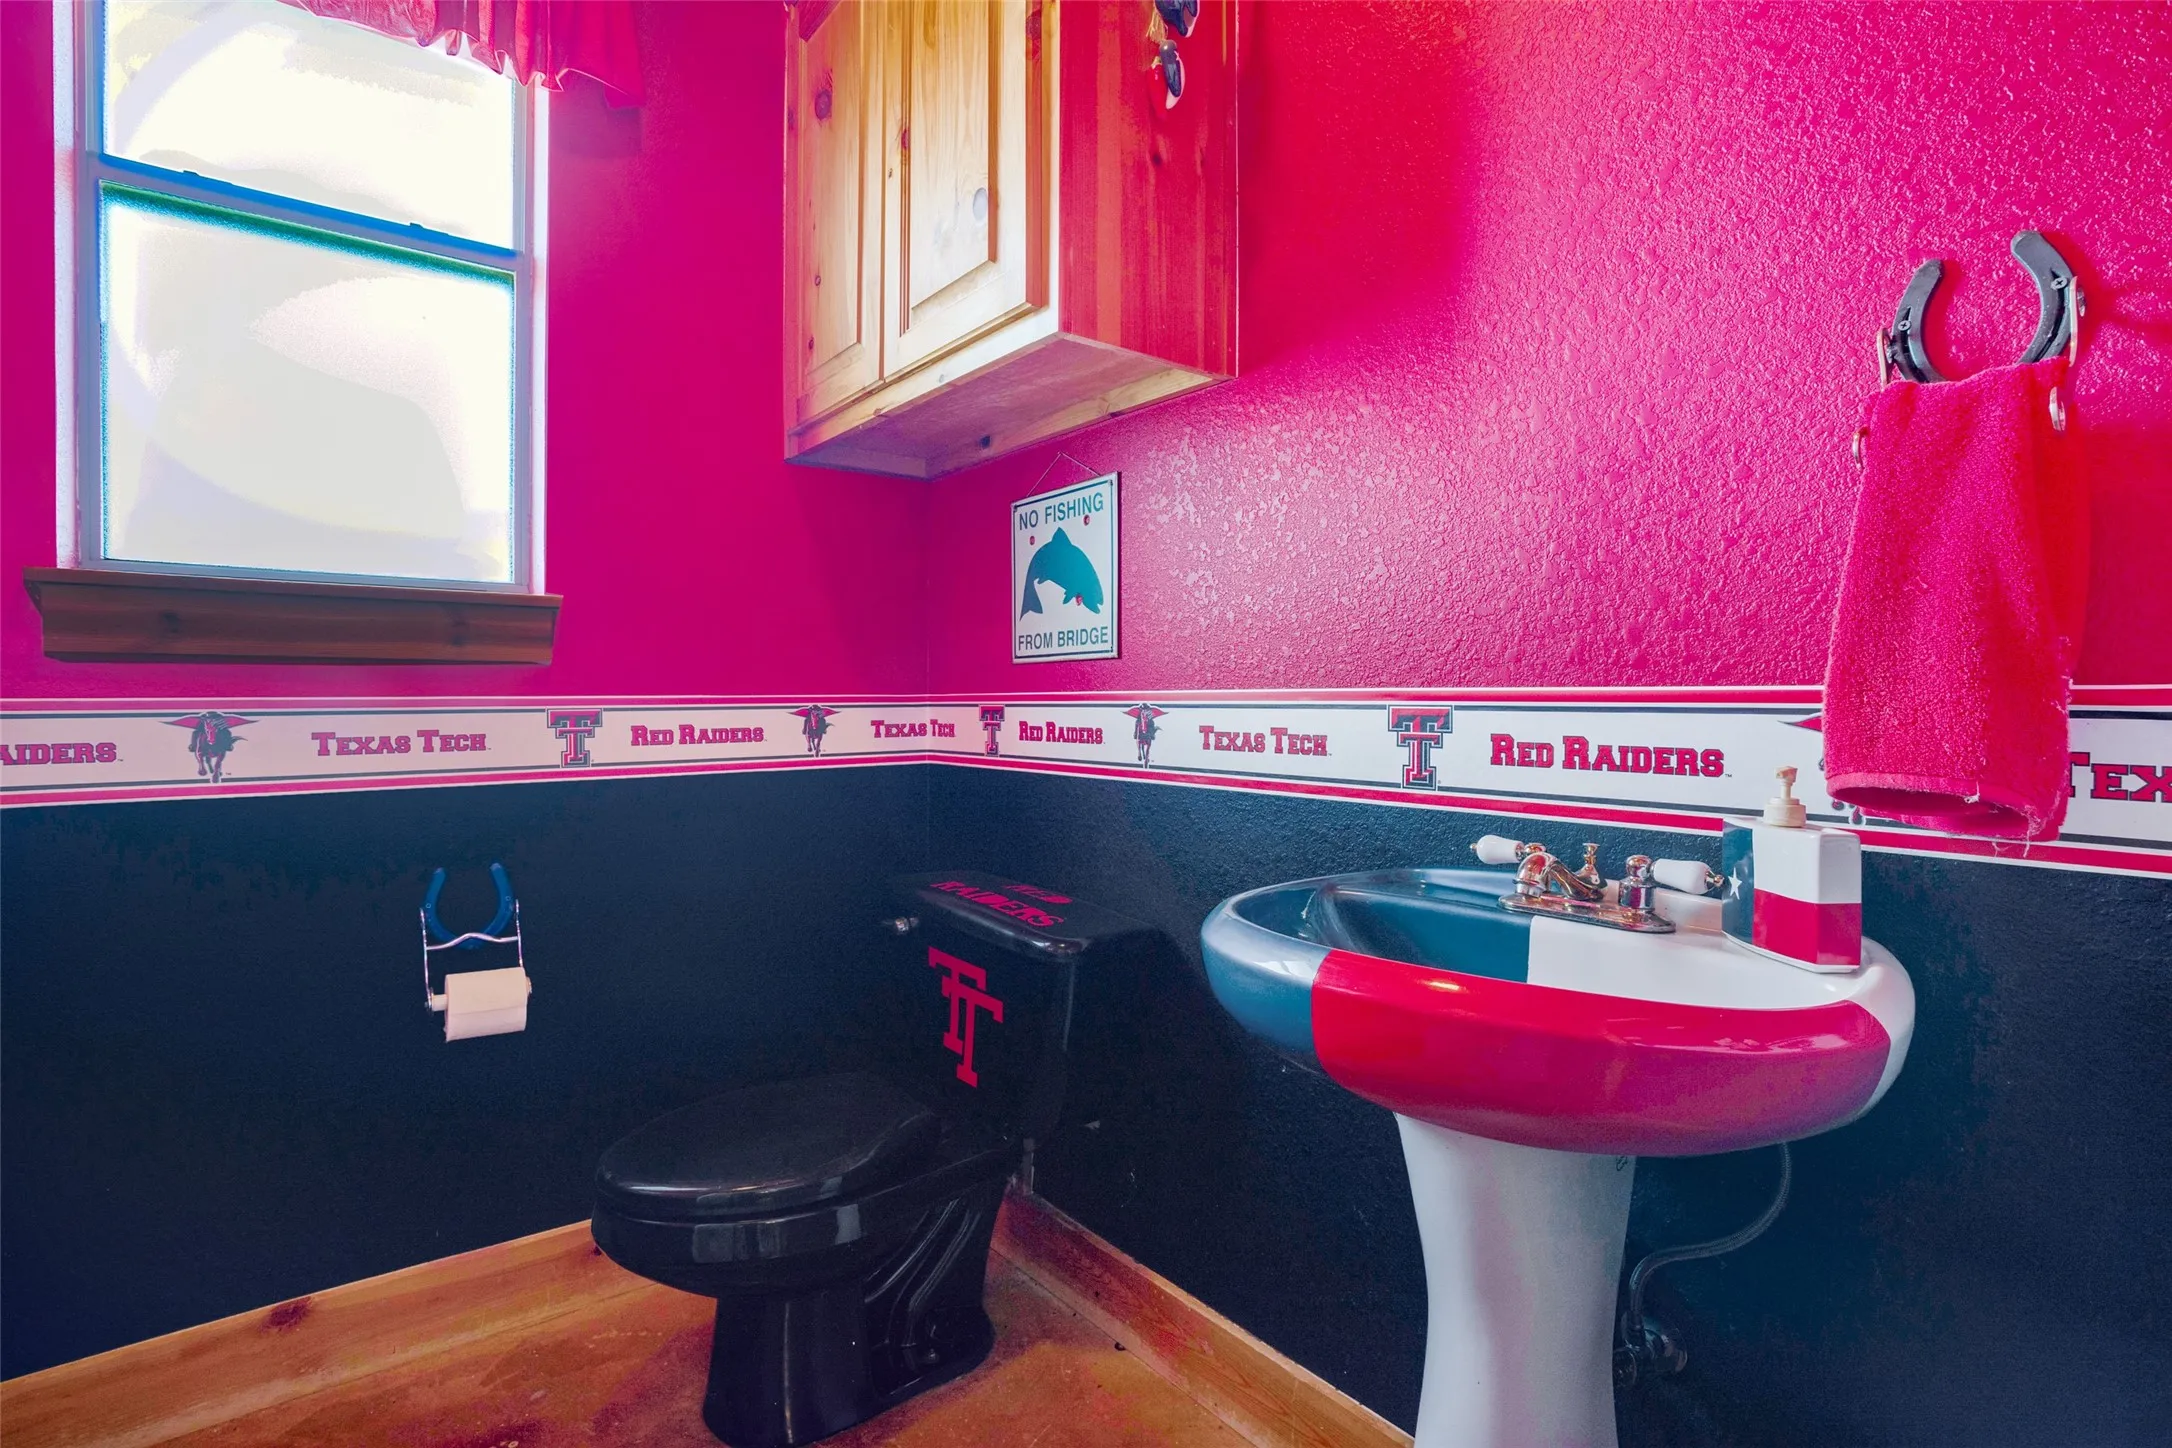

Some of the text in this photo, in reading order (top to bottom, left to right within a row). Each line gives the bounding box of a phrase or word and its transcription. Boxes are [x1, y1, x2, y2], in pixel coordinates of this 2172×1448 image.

[1019, 493, 1104, 531] NO FISHING
[1018, 626, 1109, 650] FROM BRIDGE
[630, 724, 764, 746] RED RAIDERS
[870, 719, 956, 738] TEXAS TECH
[1018, 720, 1104, 745] RED RAIDERS
[1199, 725, 1328, 756] TEXAS TECH
[311, 729, 487, 757] TEXAS TECH
[1490, 733, 1724, 778] RED RAIDERS
[930, 880, 1065, 927] RAIDERS
